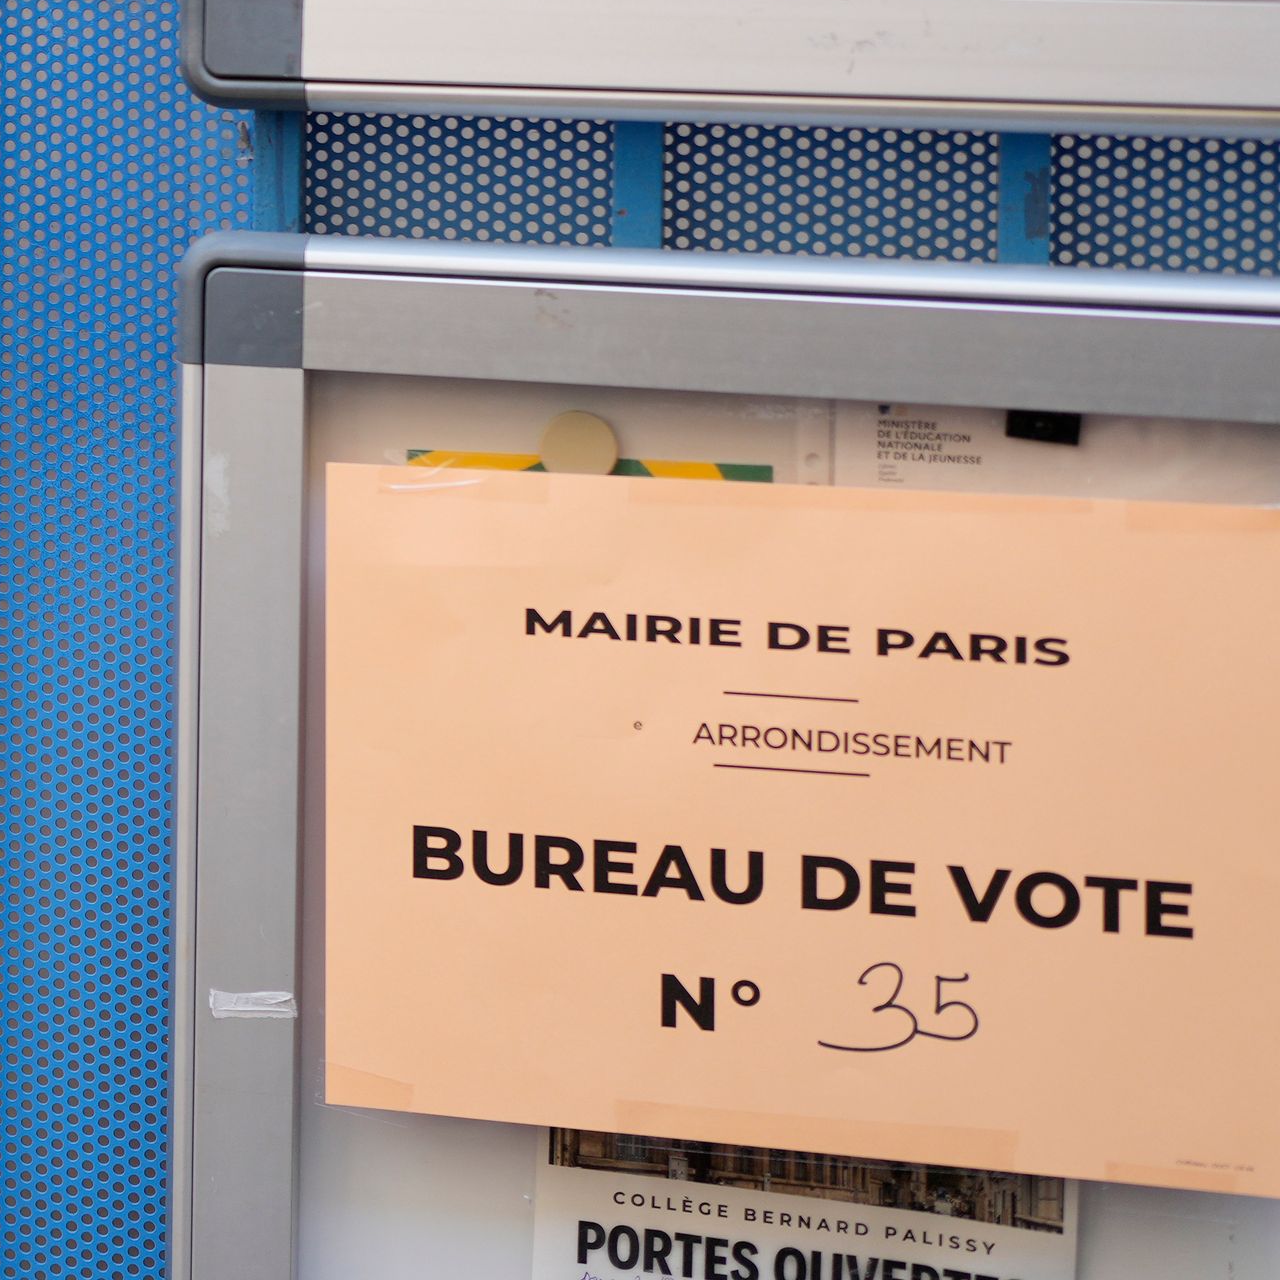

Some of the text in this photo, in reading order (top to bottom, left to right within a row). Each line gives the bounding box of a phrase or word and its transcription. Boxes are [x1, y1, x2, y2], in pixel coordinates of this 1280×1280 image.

[877, 440, 943, 452] NATIONALE
[878, 419, 937, 432] MINISTÈRE
[878, 430, 972, 443] DE L'ÉDUCATION
[877, 451, 983, 466] ET DE LA JEUNESSE
[525, 607, 1071, 667] MAIRIE DE PARIS
[692, 722, 1013, 764] ARRONDISSEMENT
[412, 824, 1195, 940] BUREAU DE VOTE
[660, 962, 980, 1052] N° 35
[612, 1190, 998, 1257] COLLÈGE BERNARD PALISSY
[577, 1220, 760, 1280] PORTES
